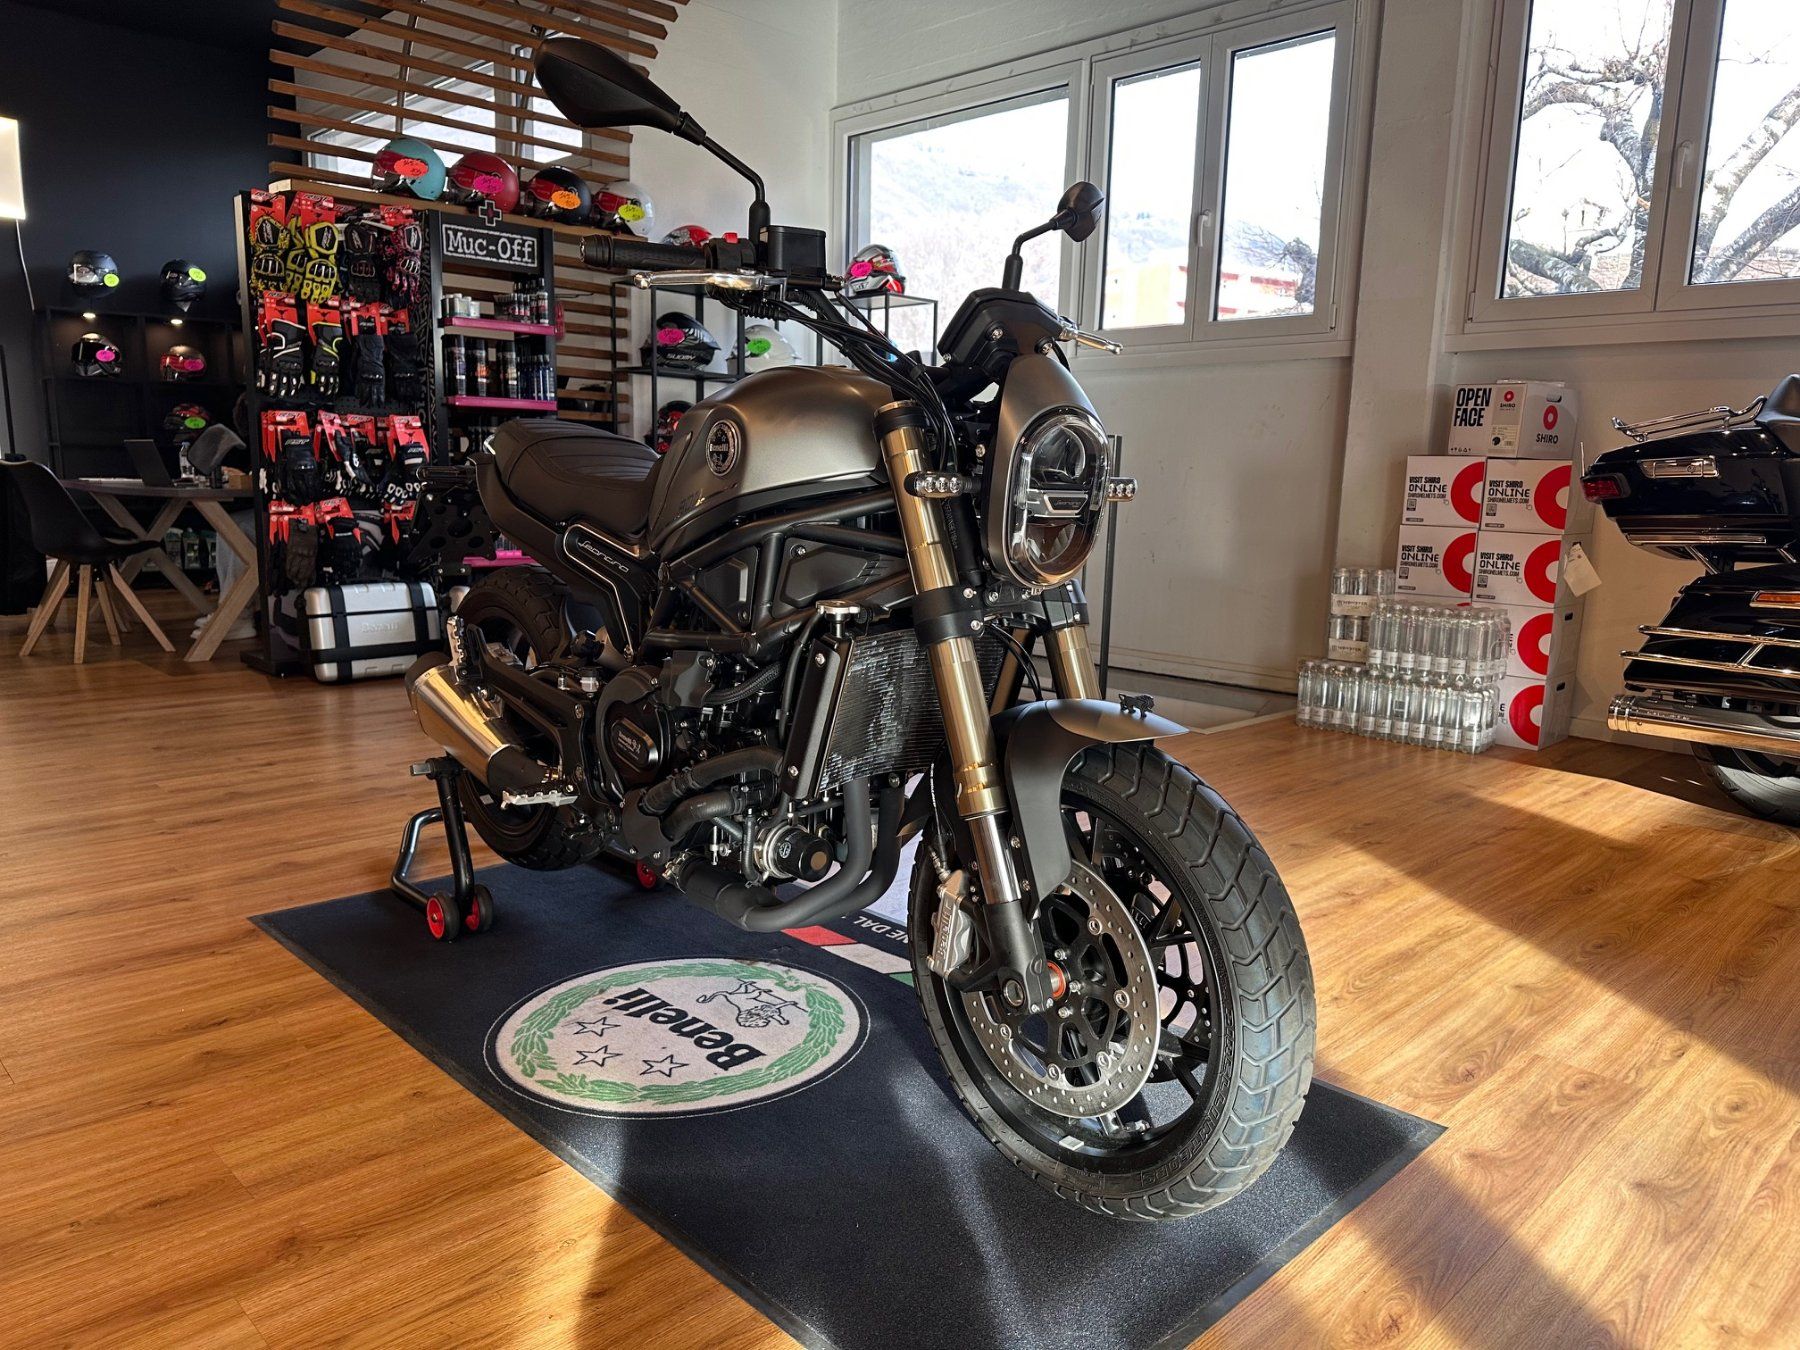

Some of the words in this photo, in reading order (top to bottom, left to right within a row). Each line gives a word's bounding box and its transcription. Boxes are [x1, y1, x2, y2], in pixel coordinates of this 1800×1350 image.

[447, 230, 534, 264] Muc-Off
[1456, 387, 1492, 407] OPEN
[1453, 407, 1486, 427] FACE
[1536, 433, 1559, 444] SHIRO
[1409, 476, 1424, 484] VISIT
[1424, 476, 1441, 484] SHIRO
[1489, 480, 1504, 488] VISIT
[1505, 480, 1524, 488] SHIRO
[1409, 484, 1447, 493] ONLINE
[1488, 488, 1530, 498] ONLINE
[1402, 544, 1416, 552] VISIT
[1416, 545, 1433, 553] SHIRO
[1401, 552, 1440, 562] ONLINE
[1480, 551, 1495, 560] VISIT
[1496, 552, 1514, 561] SHIRO
[1479, 559, 1521, 571] ONLINE
[853, 915, 892, 934] DAL
[602, 987, 767, 1071] Benelli
